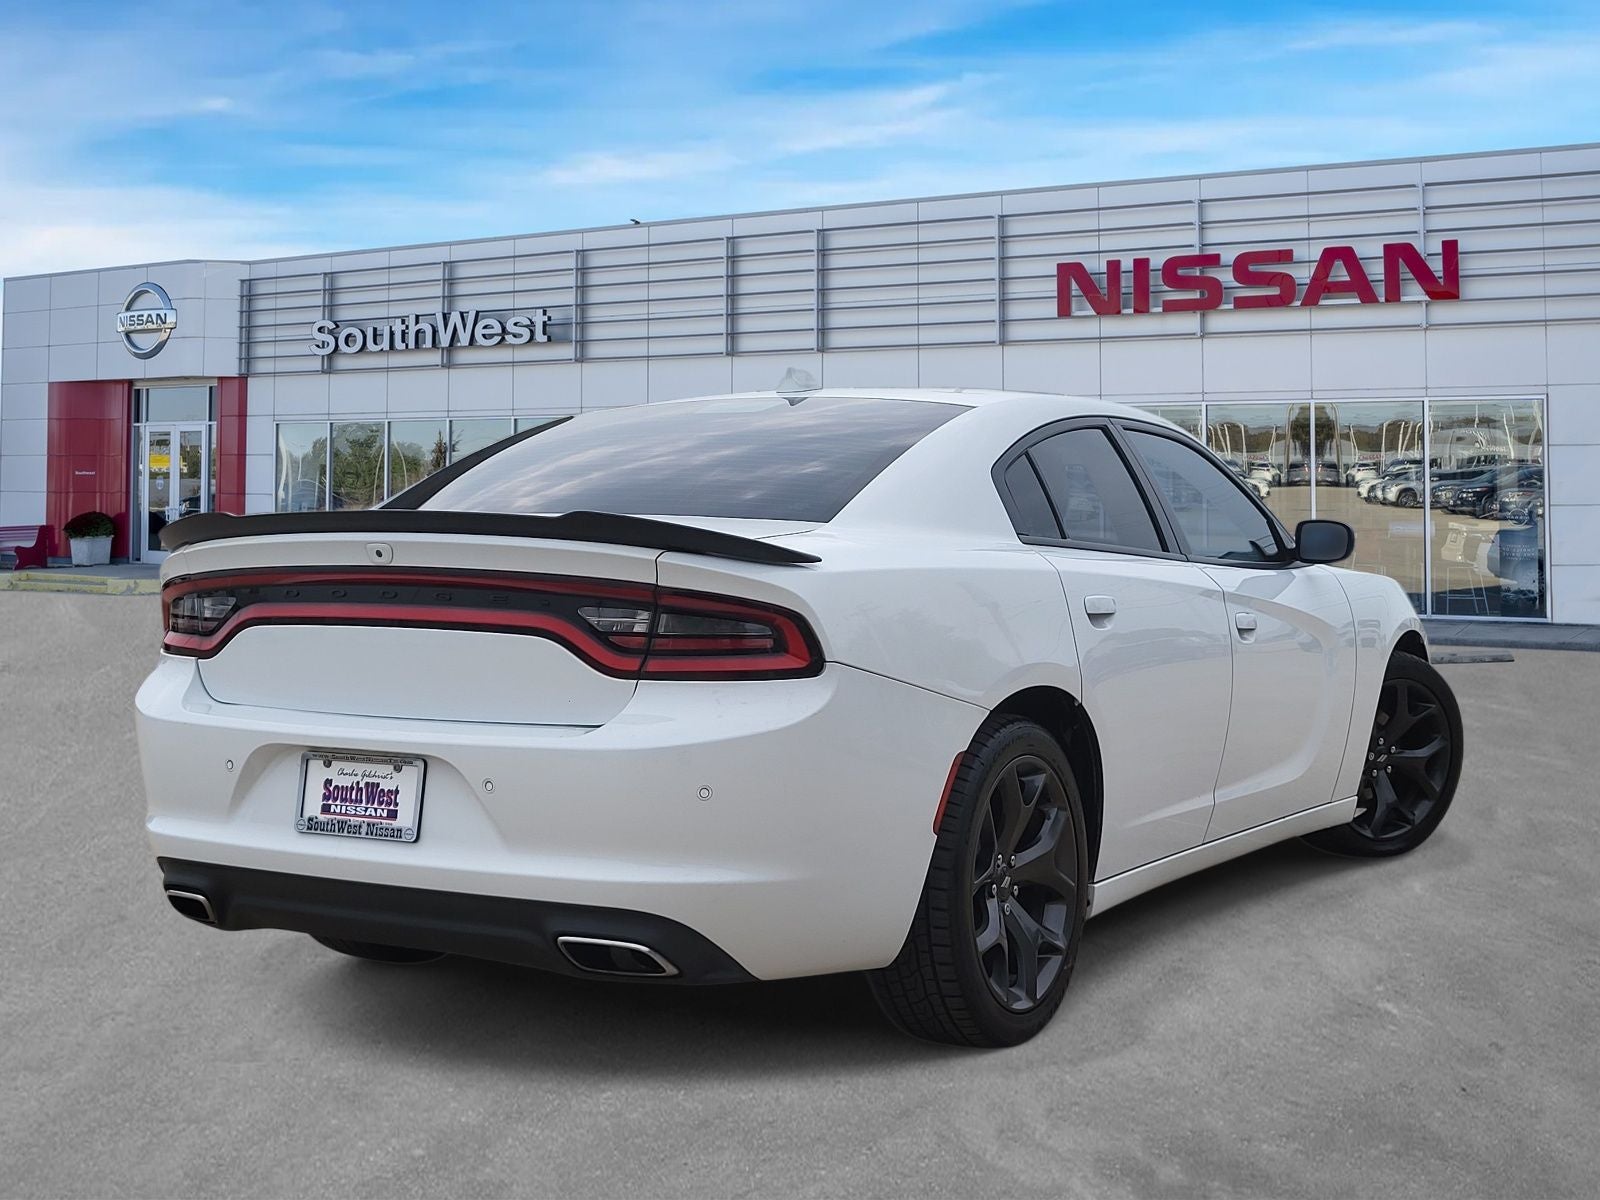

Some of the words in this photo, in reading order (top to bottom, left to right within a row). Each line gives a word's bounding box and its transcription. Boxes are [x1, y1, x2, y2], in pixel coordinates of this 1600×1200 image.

[1056, 239, 1460, 318] NISSAN
[119, 312, 167, 328] NISSAN
[308, 308, 551, 357] SouthWest
[337, 767, 359, 777] Charlie
[322, 778, 400, 808] SouthWest
[330, 805, 388, 817] NISSAN
[306, 816, 364, 836] SouthWest
[365, 821, 403, 839] Nissan
